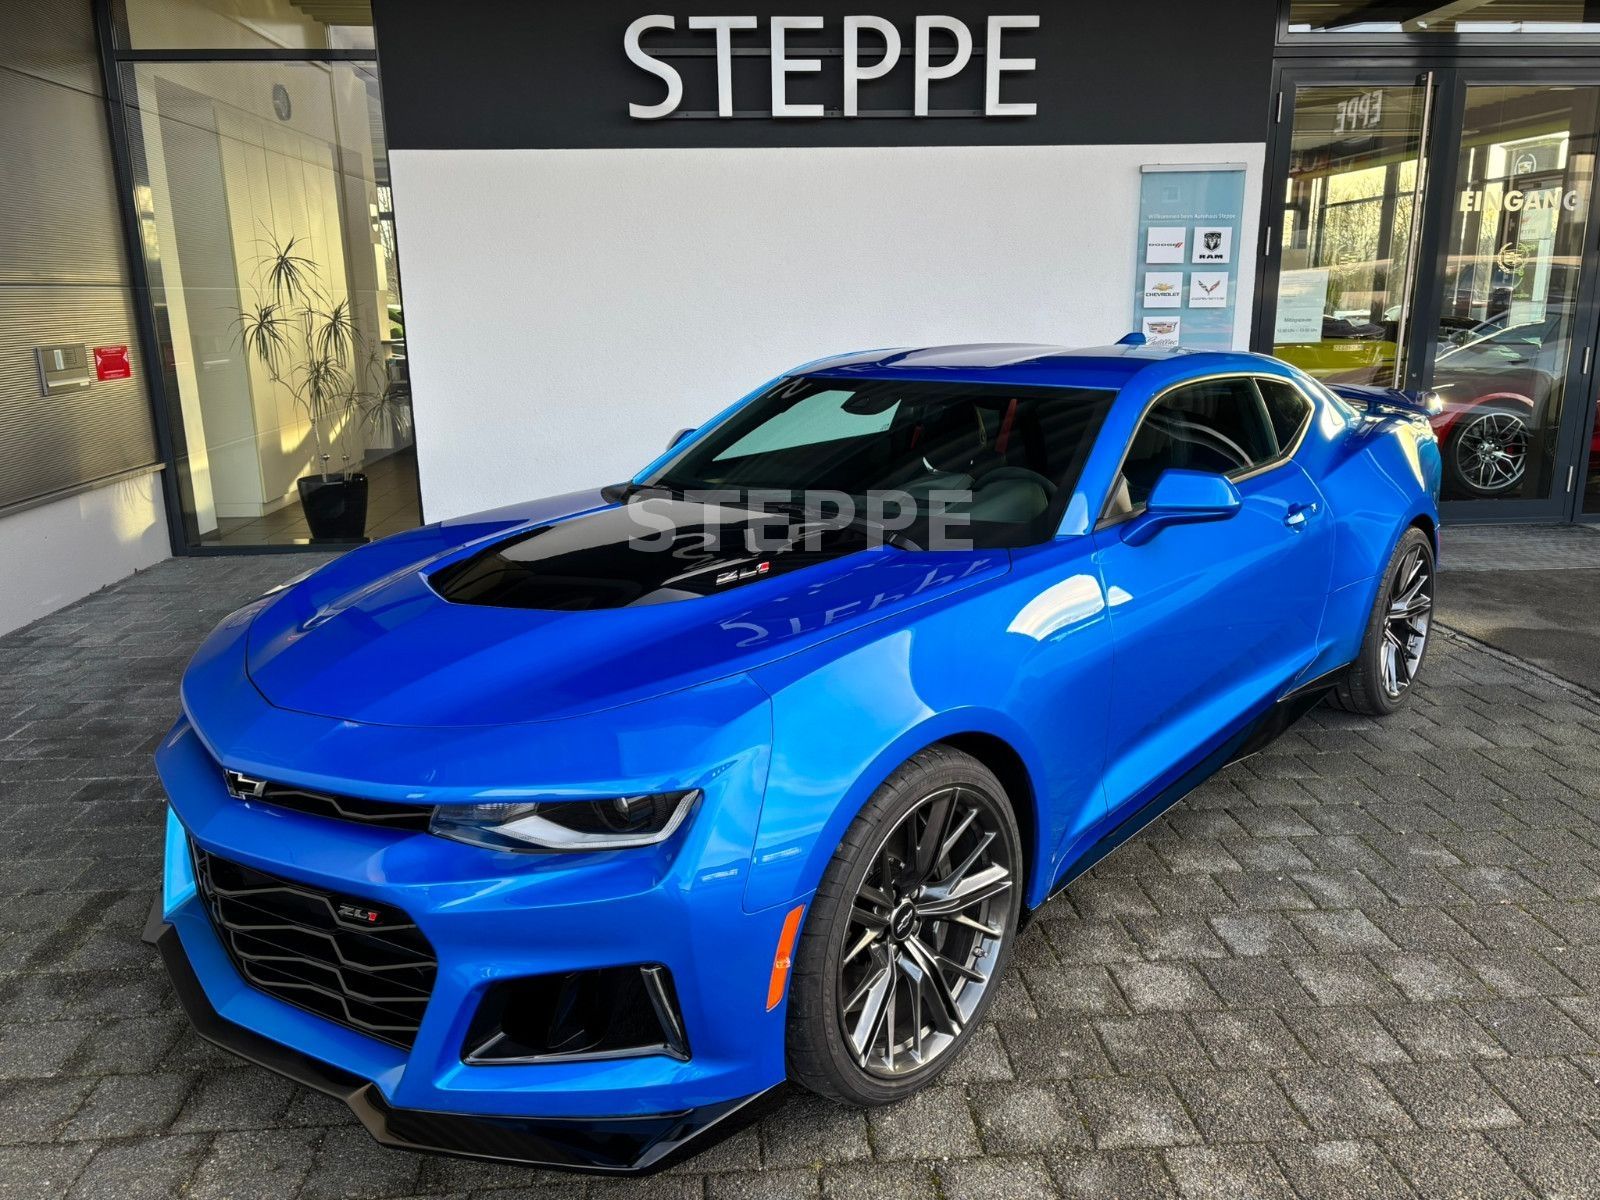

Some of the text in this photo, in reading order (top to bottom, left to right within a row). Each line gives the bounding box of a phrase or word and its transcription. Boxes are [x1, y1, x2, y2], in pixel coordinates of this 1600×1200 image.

[624, 14, 1040, 119] STEPPE
[1460, 190, 1583, 211] EINGANG
[716, 561, 770, 586] ZL1
[338, 905, 378, 921] ZL1
